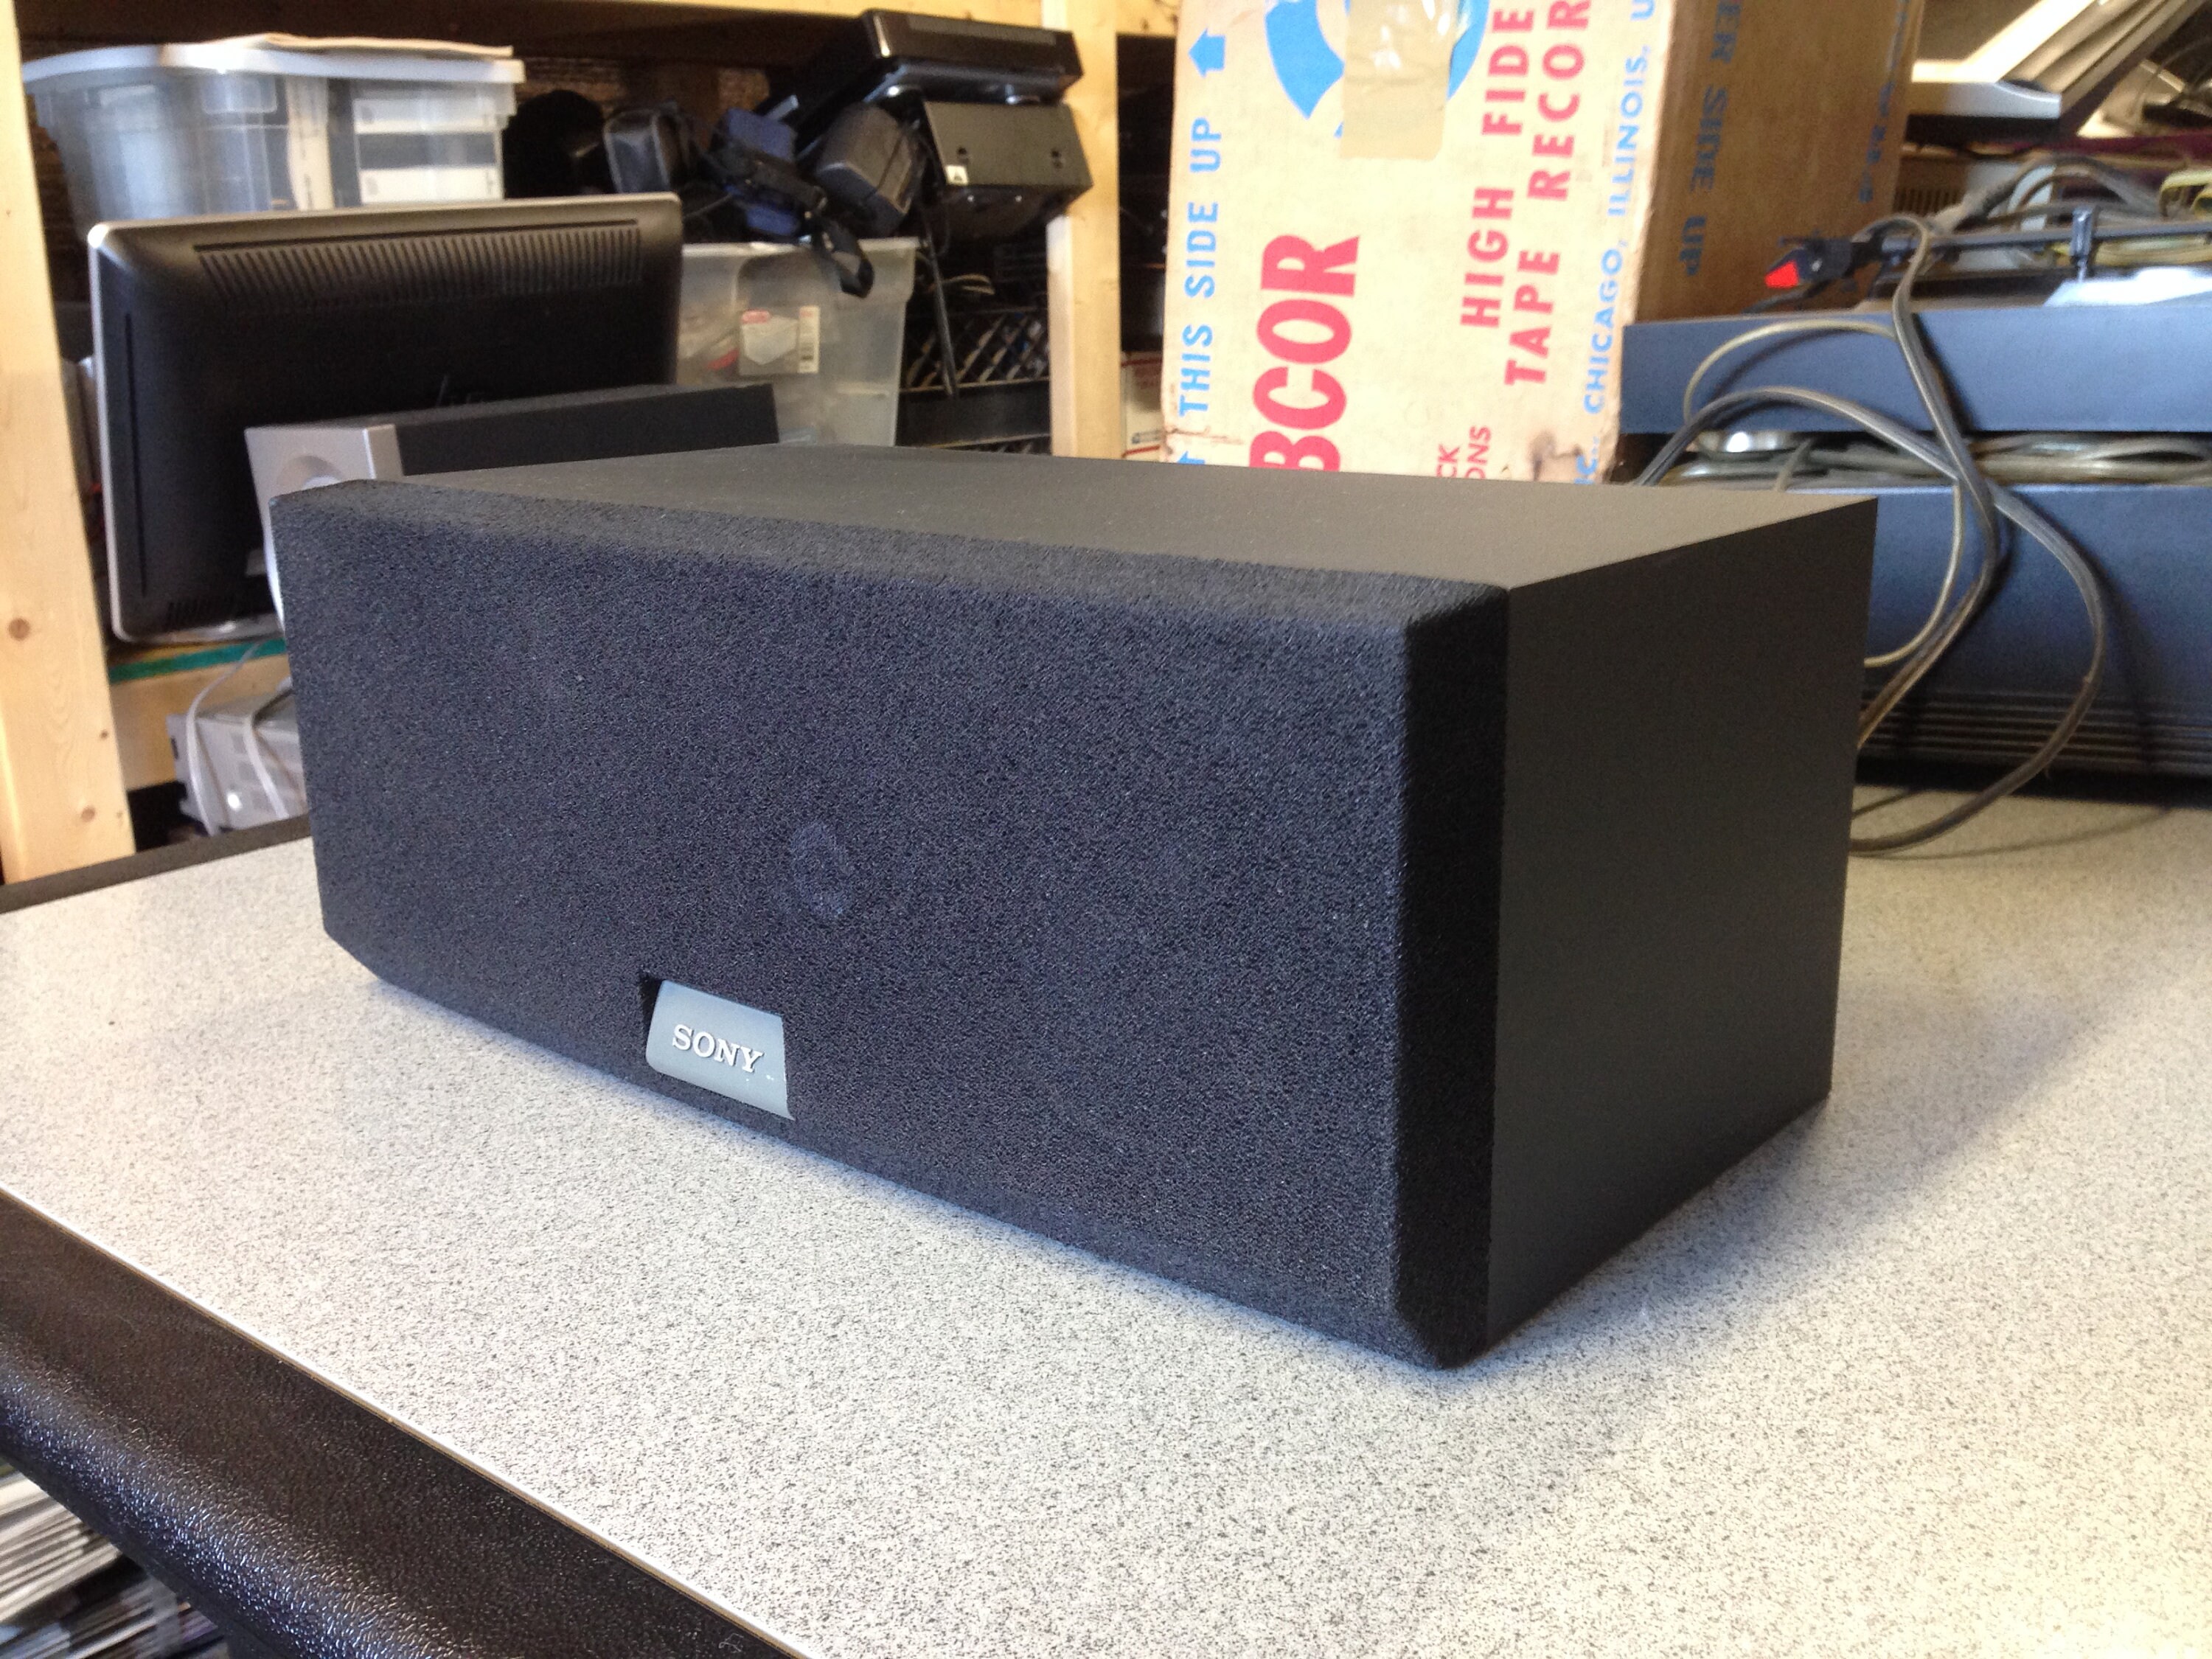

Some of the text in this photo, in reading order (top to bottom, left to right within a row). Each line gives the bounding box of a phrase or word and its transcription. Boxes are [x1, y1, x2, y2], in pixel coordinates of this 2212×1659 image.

[1460, 8, 1534, 328] HIGH FIDE
[1503, 0, 1592, 386] TAPE RECOR
[1678, 215, 1708, 276] UP
[1690, 84, 1729, 193] SIDE
[1178, 116, 1222, 417] THIS SIDE UP
[1248, 234, 1360, 473] BCOR
[672, 1023, 764, 1074] SONY
